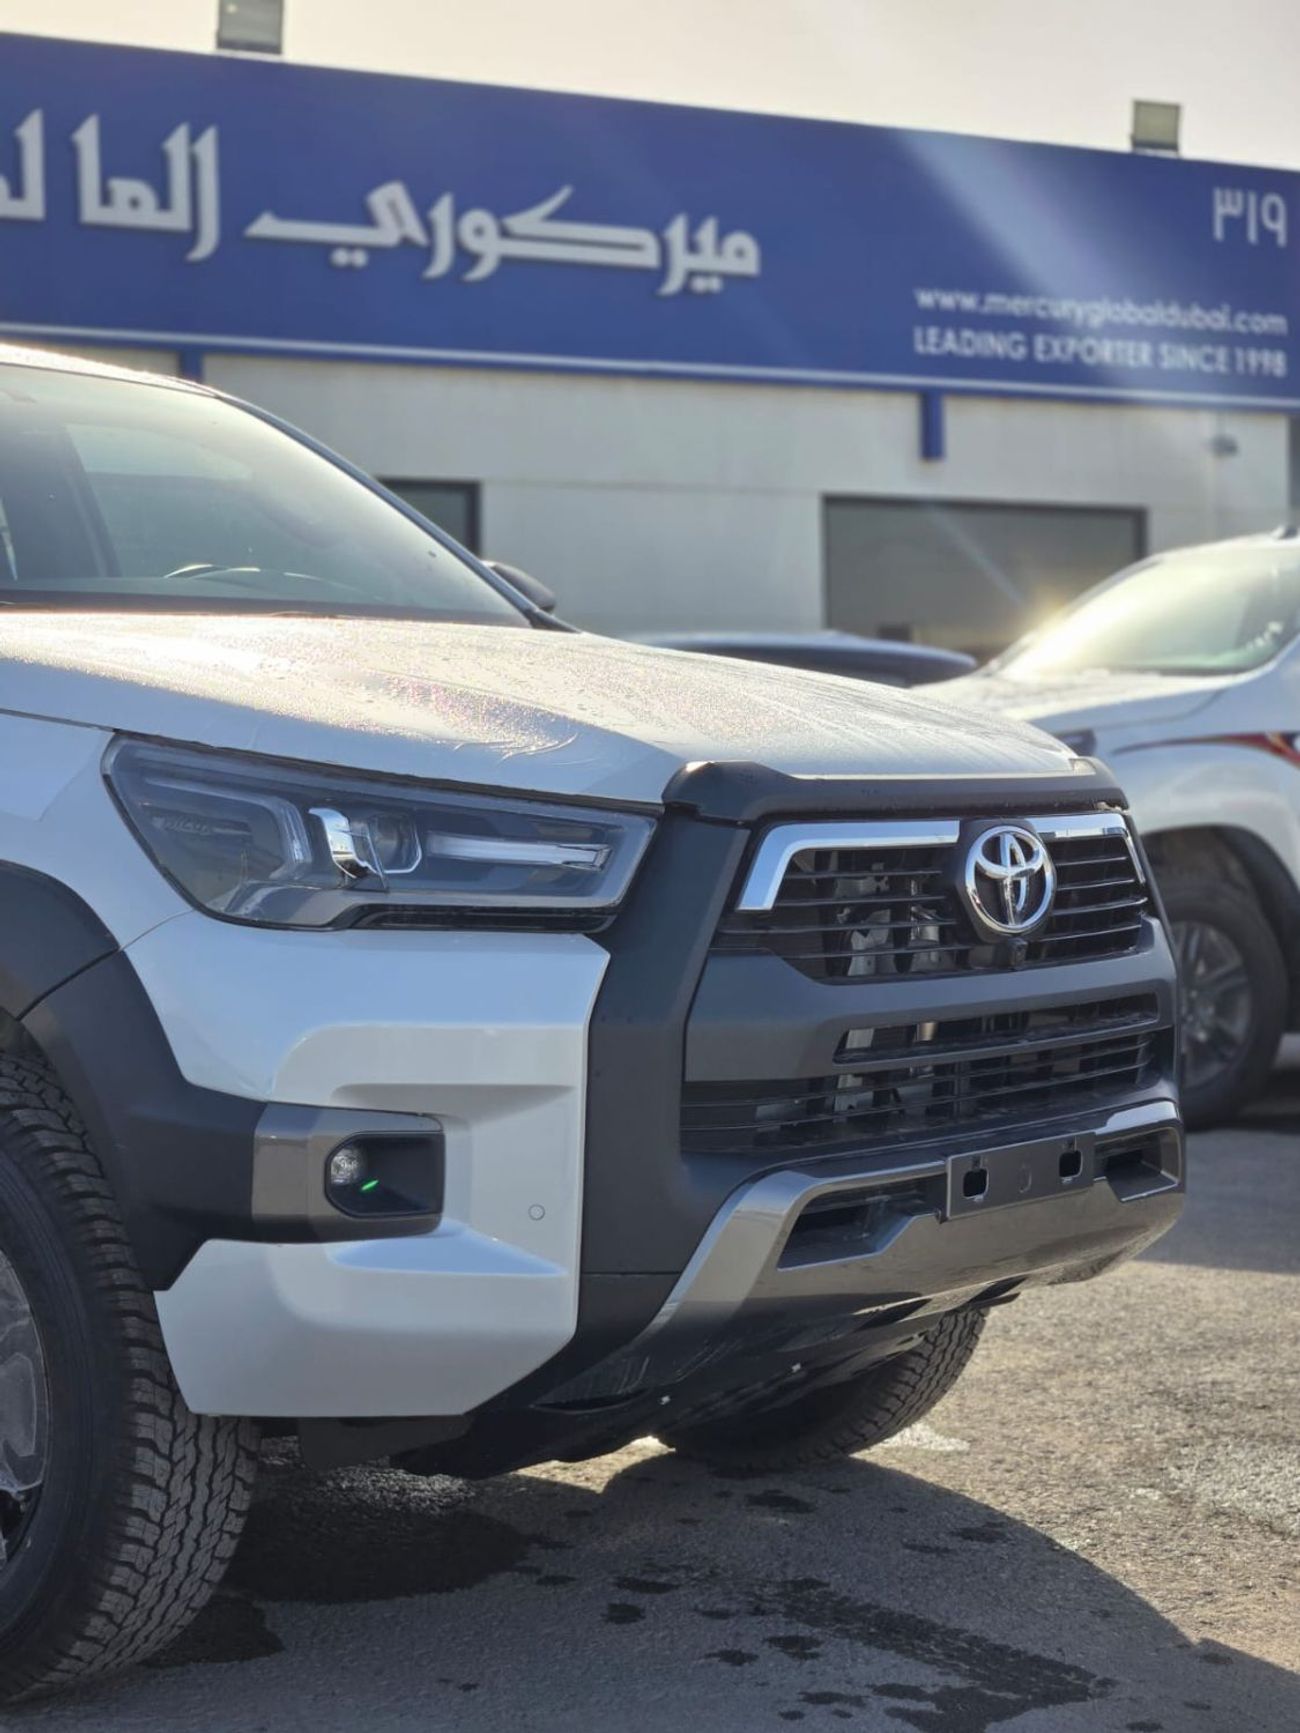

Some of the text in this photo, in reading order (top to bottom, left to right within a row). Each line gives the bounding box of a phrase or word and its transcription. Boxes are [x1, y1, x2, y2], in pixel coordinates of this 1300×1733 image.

[245, 181, 761, 296] ميركوري
[914, 326, 1288, 377] LEADING EXPORTER SINCE 1998
